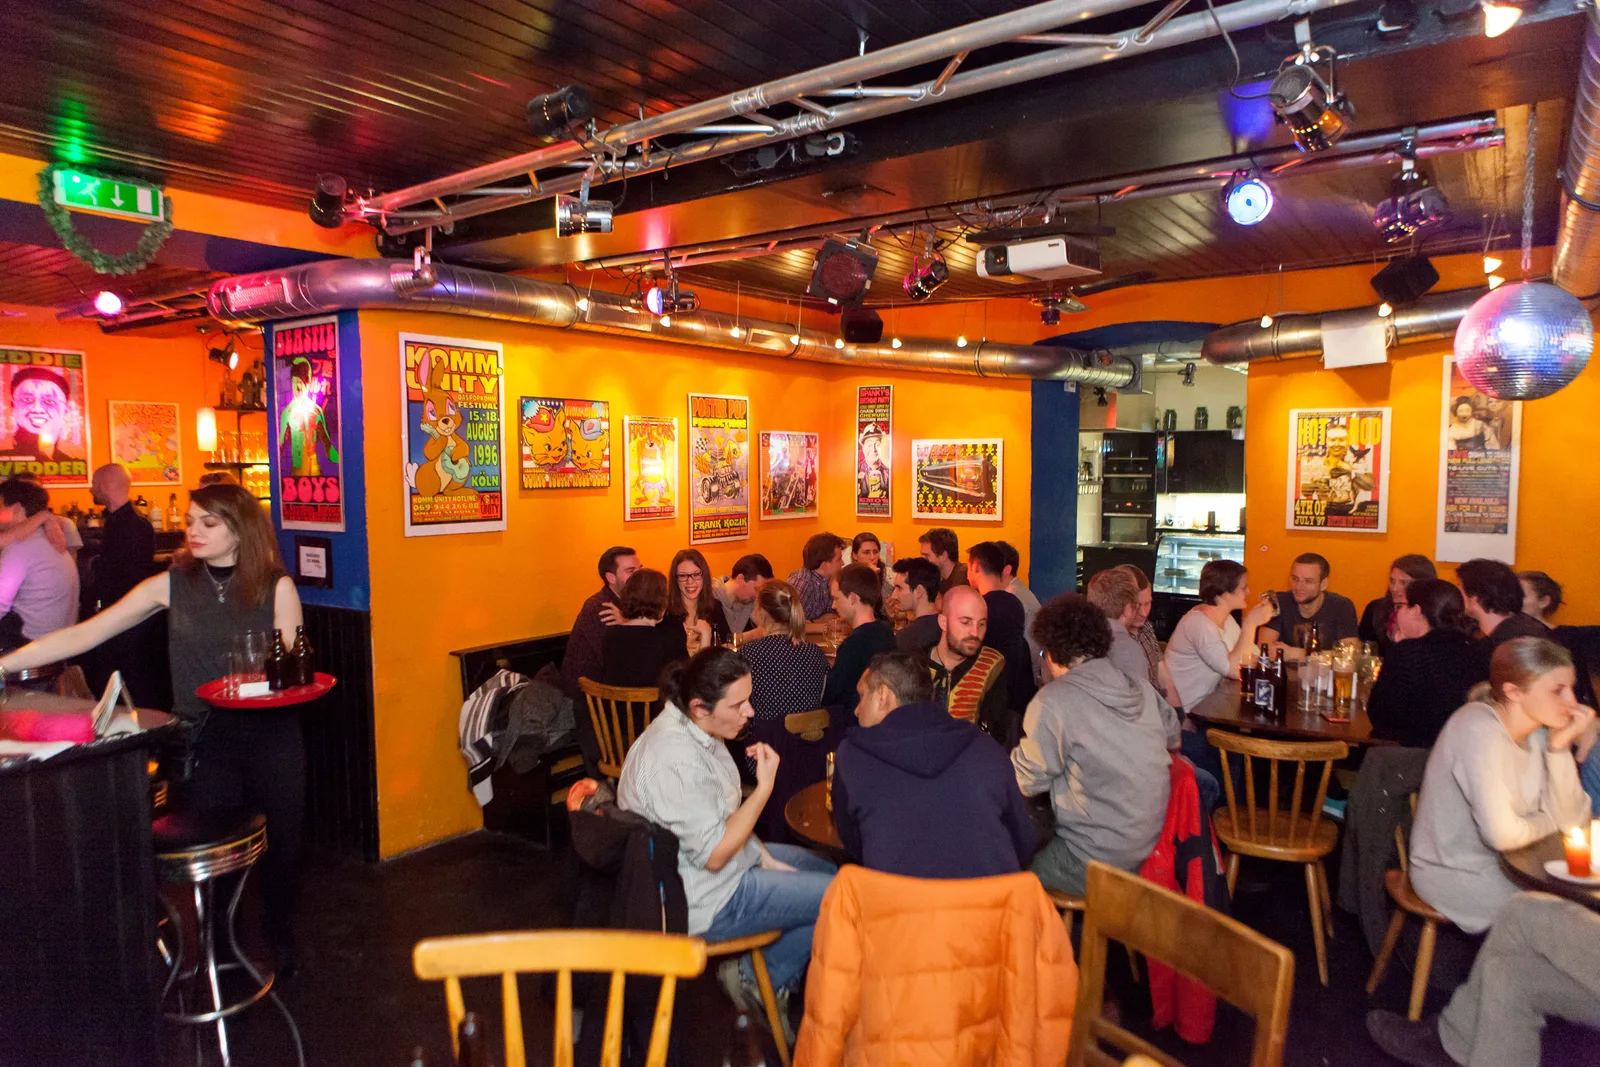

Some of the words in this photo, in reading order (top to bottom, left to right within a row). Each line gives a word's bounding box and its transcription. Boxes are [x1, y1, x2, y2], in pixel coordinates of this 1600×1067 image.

[275, 323, 335, 357] BEASTIE
[457, 401, 498, 410] FESTIVAL
[692, 397, 727, 418] POSTER
[728, 399, 747, 419] POP
[466, 422, 498, 440] AUGUST
[692, 417, 747, 428] PRODUCTIONS
[1298, 417, 1328, 446] HOT
[473, 444, 498, 466] 1996
[471, 471, 499, 487] KÖLN
[282, 477, 339, 503] BOYS
[1295, 499, 1314, 515] 4TH
[693, 519, 722, 530] FRANK
[723, 518, 748, 529] KOZIK
[1295, 516, 1315, 525] JULY
